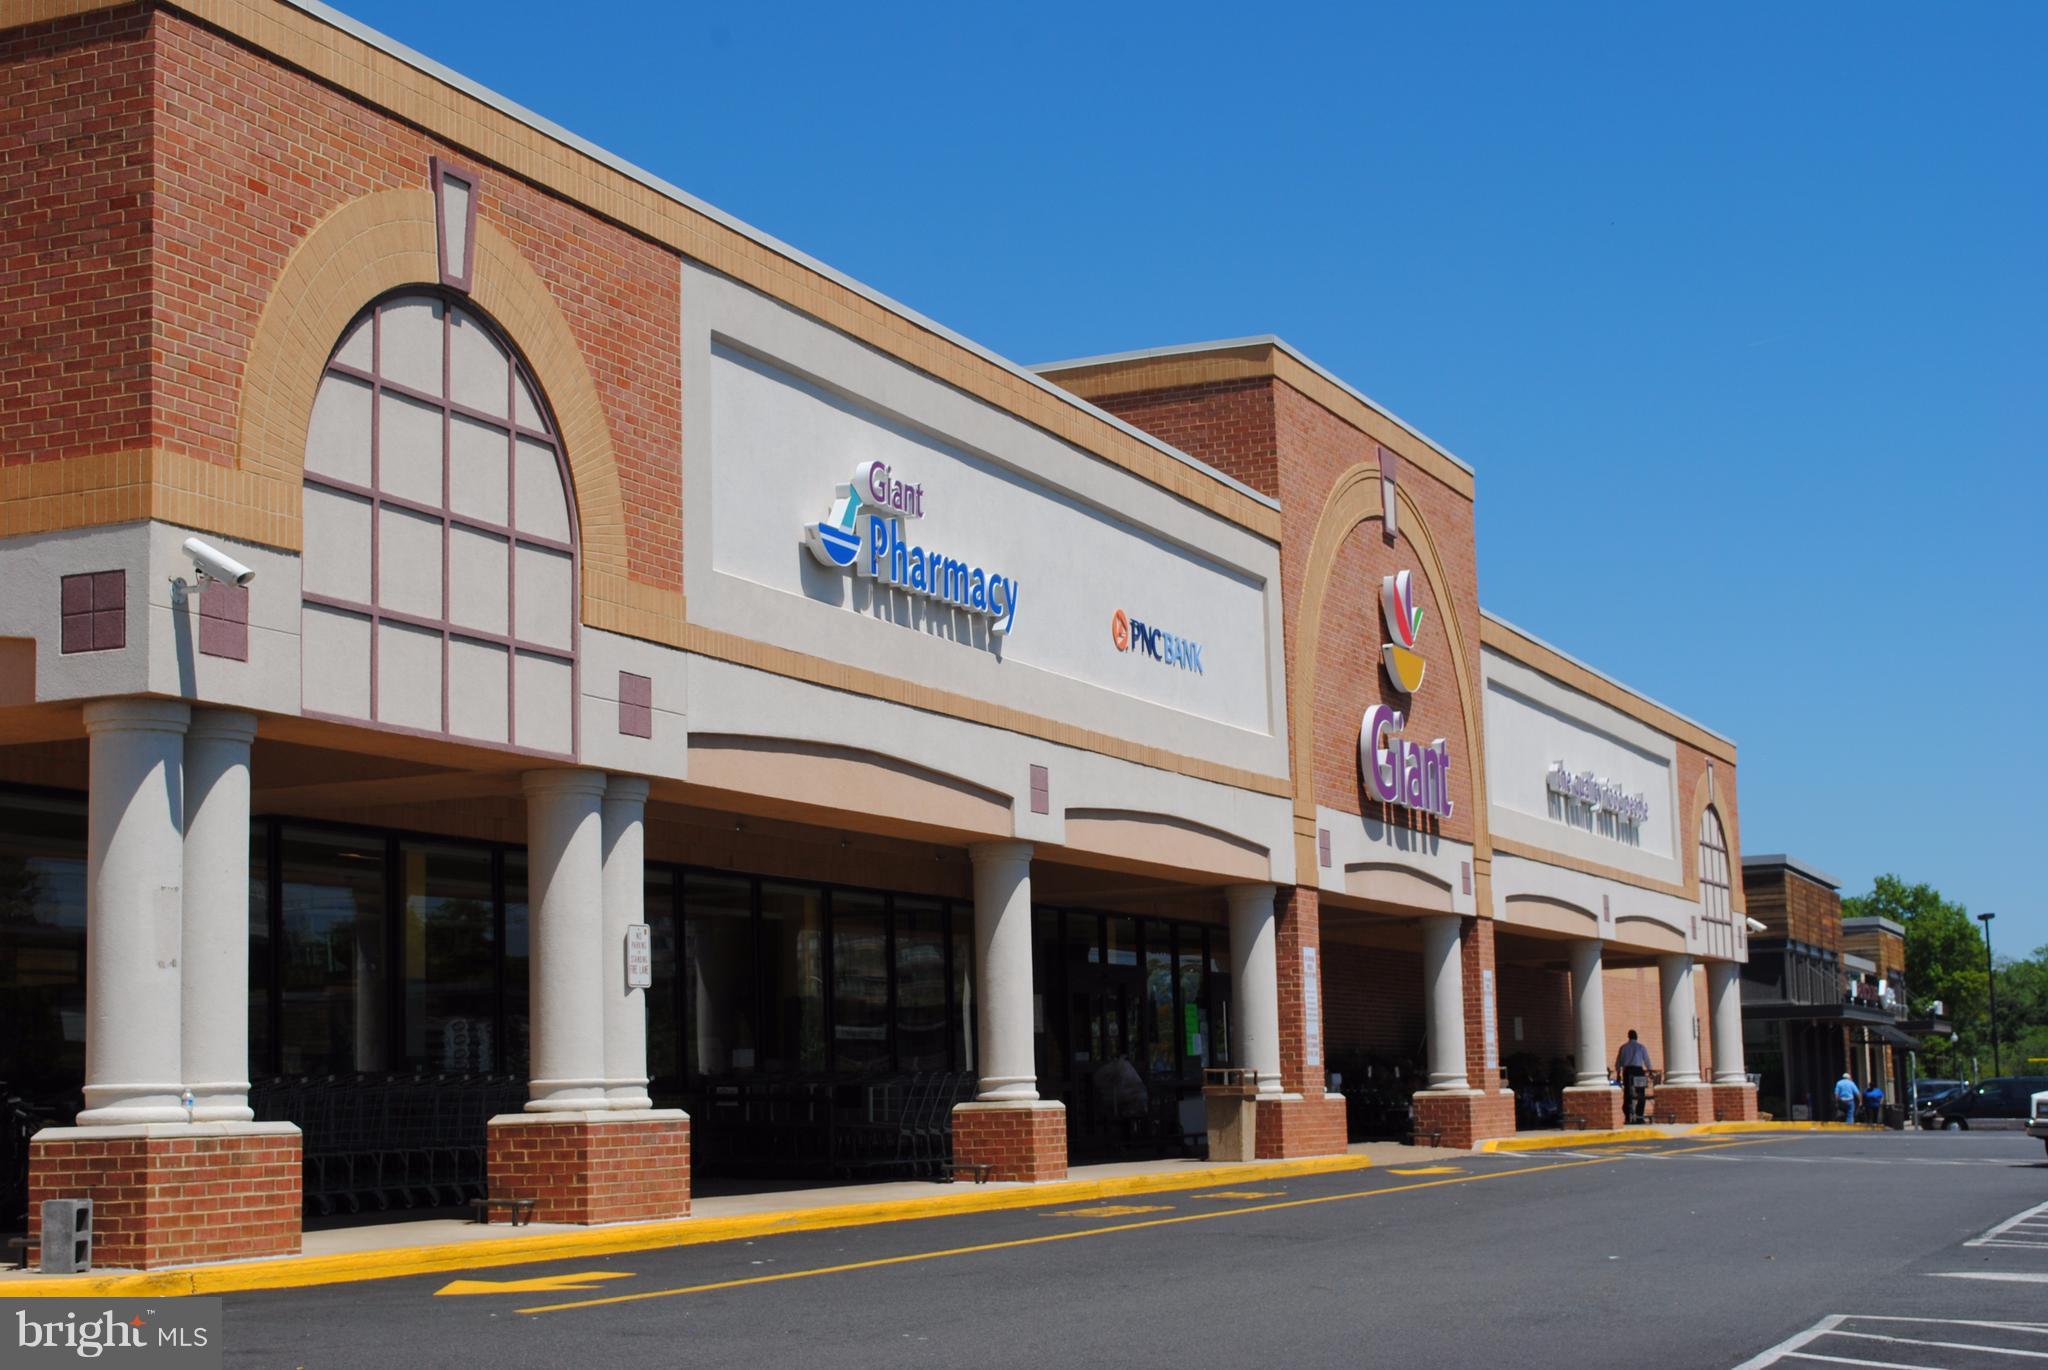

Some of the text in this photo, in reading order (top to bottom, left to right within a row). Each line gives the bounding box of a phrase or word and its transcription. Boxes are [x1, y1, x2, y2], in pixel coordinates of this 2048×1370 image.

[866, 460, 925, 519] Giant
[869, 514, 1019, 636] Pharmacy
[1129, 619, 1205, 675] PNC BANK
[1365, 703, 1454, 818] Giant
